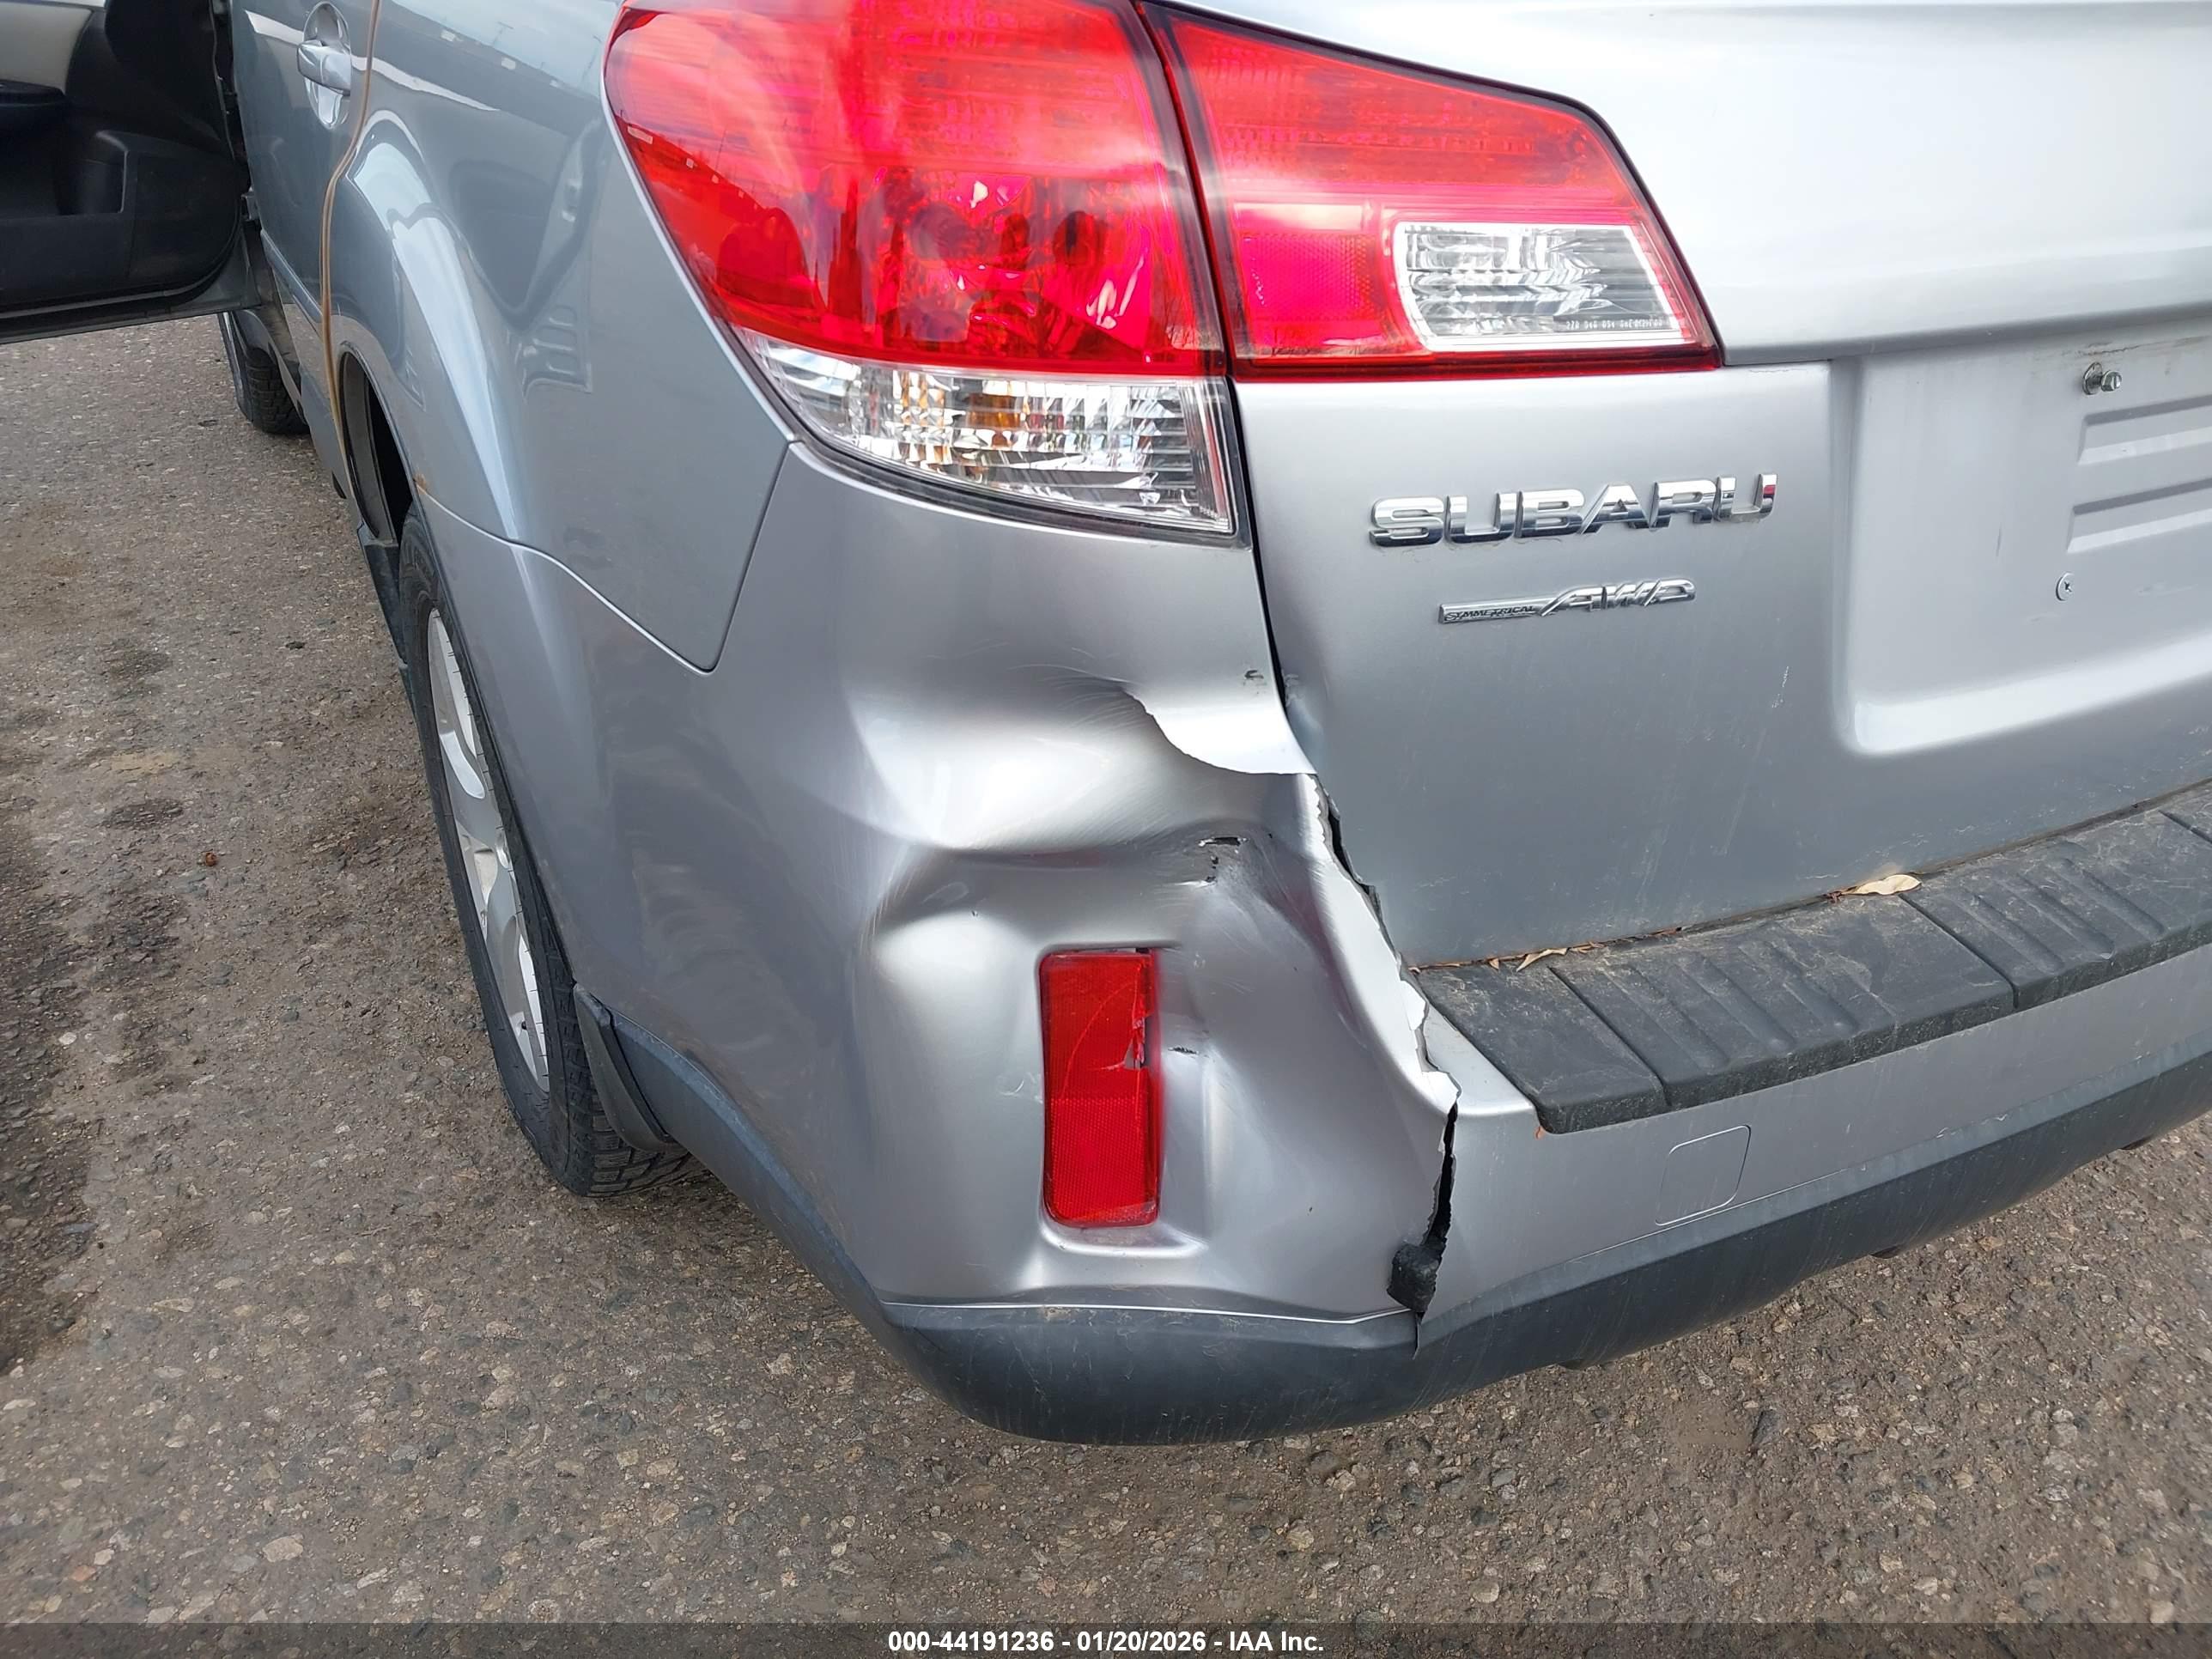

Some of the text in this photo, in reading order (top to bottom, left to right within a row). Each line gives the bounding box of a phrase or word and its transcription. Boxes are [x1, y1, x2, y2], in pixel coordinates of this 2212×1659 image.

[1369, 473, 1778, 548] SUBARU
[1443, 578, 1697, 622] SYMMETRICAL AWD
